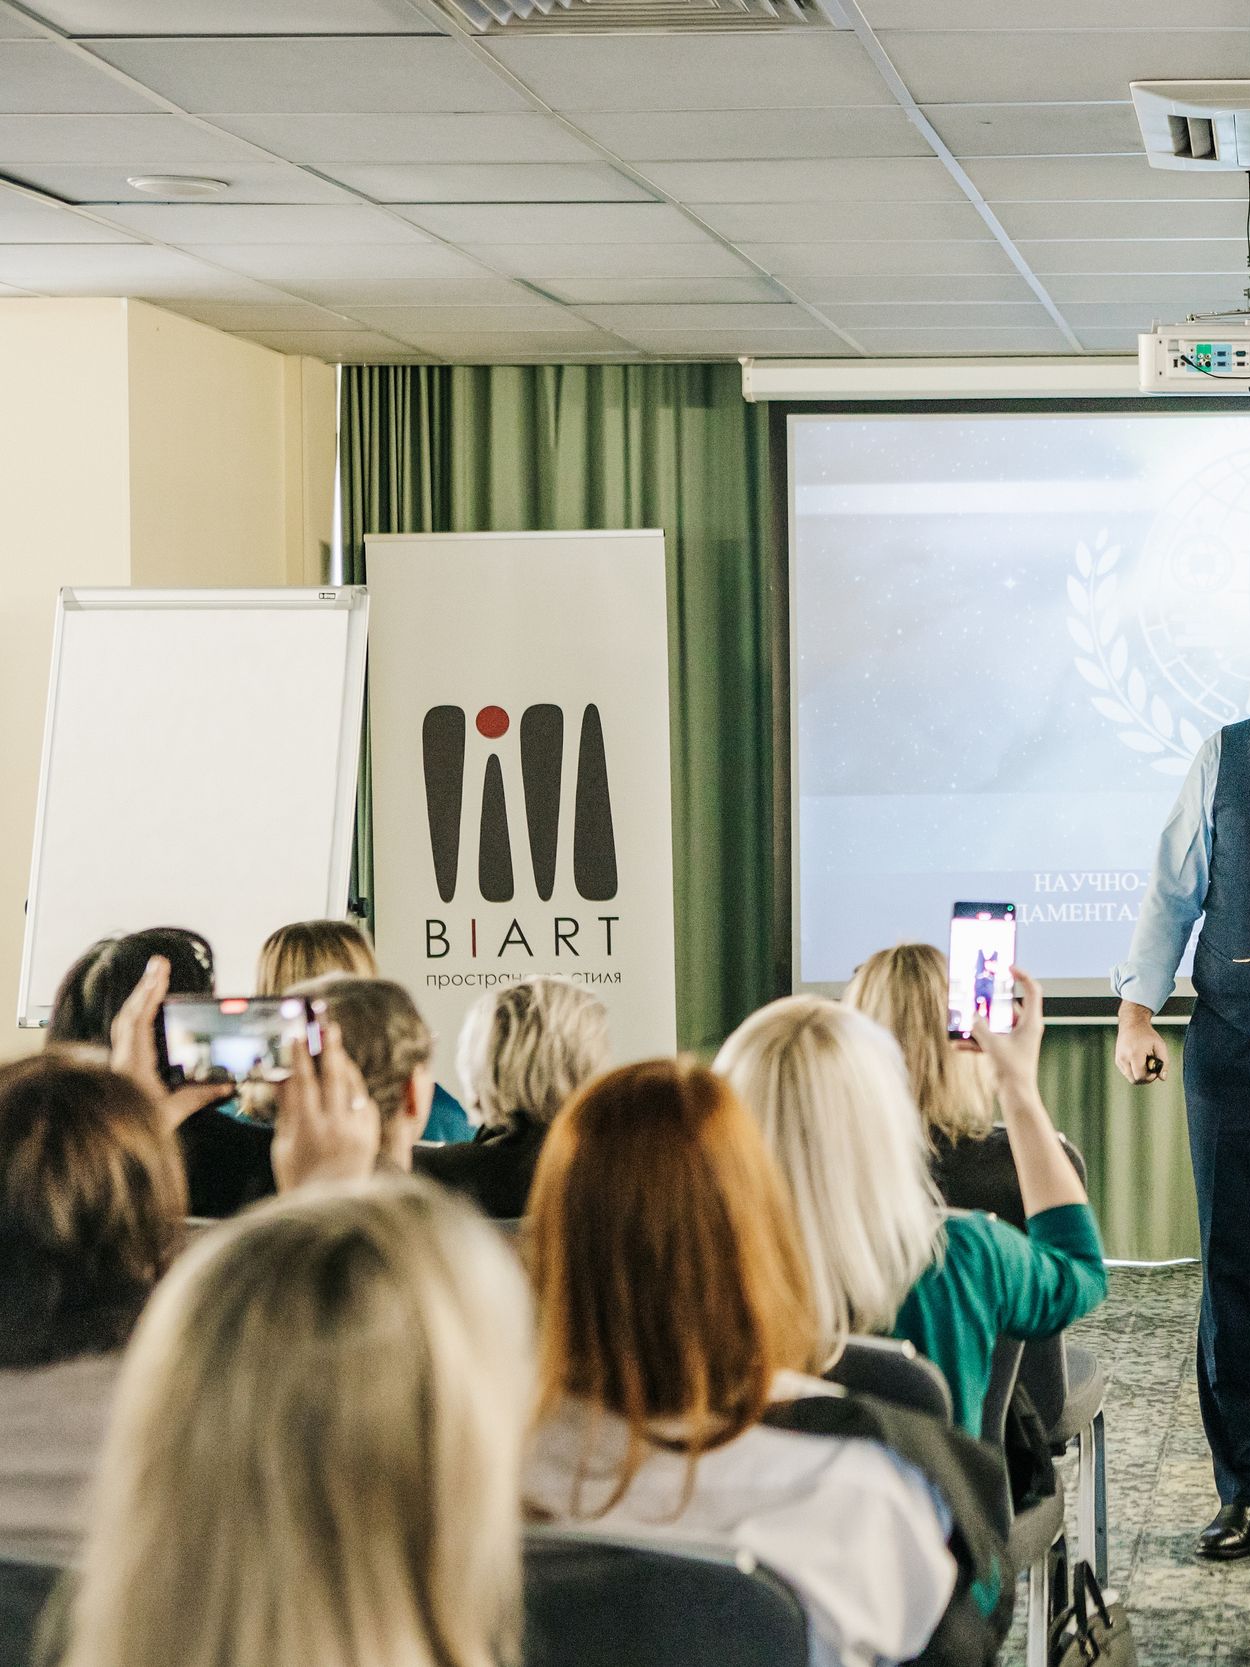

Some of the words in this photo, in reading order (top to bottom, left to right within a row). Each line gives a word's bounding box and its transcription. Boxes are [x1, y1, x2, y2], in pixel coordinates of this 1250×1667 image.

[1032, 871, 1152, 893] НАУЧНО-
[1015, 902, 1143, 926] ДАМЕНТА
[425, 916, 620, 958] BIART
[426, 972, 563, 990] простран
[571, 971, 622, 986] стиля
